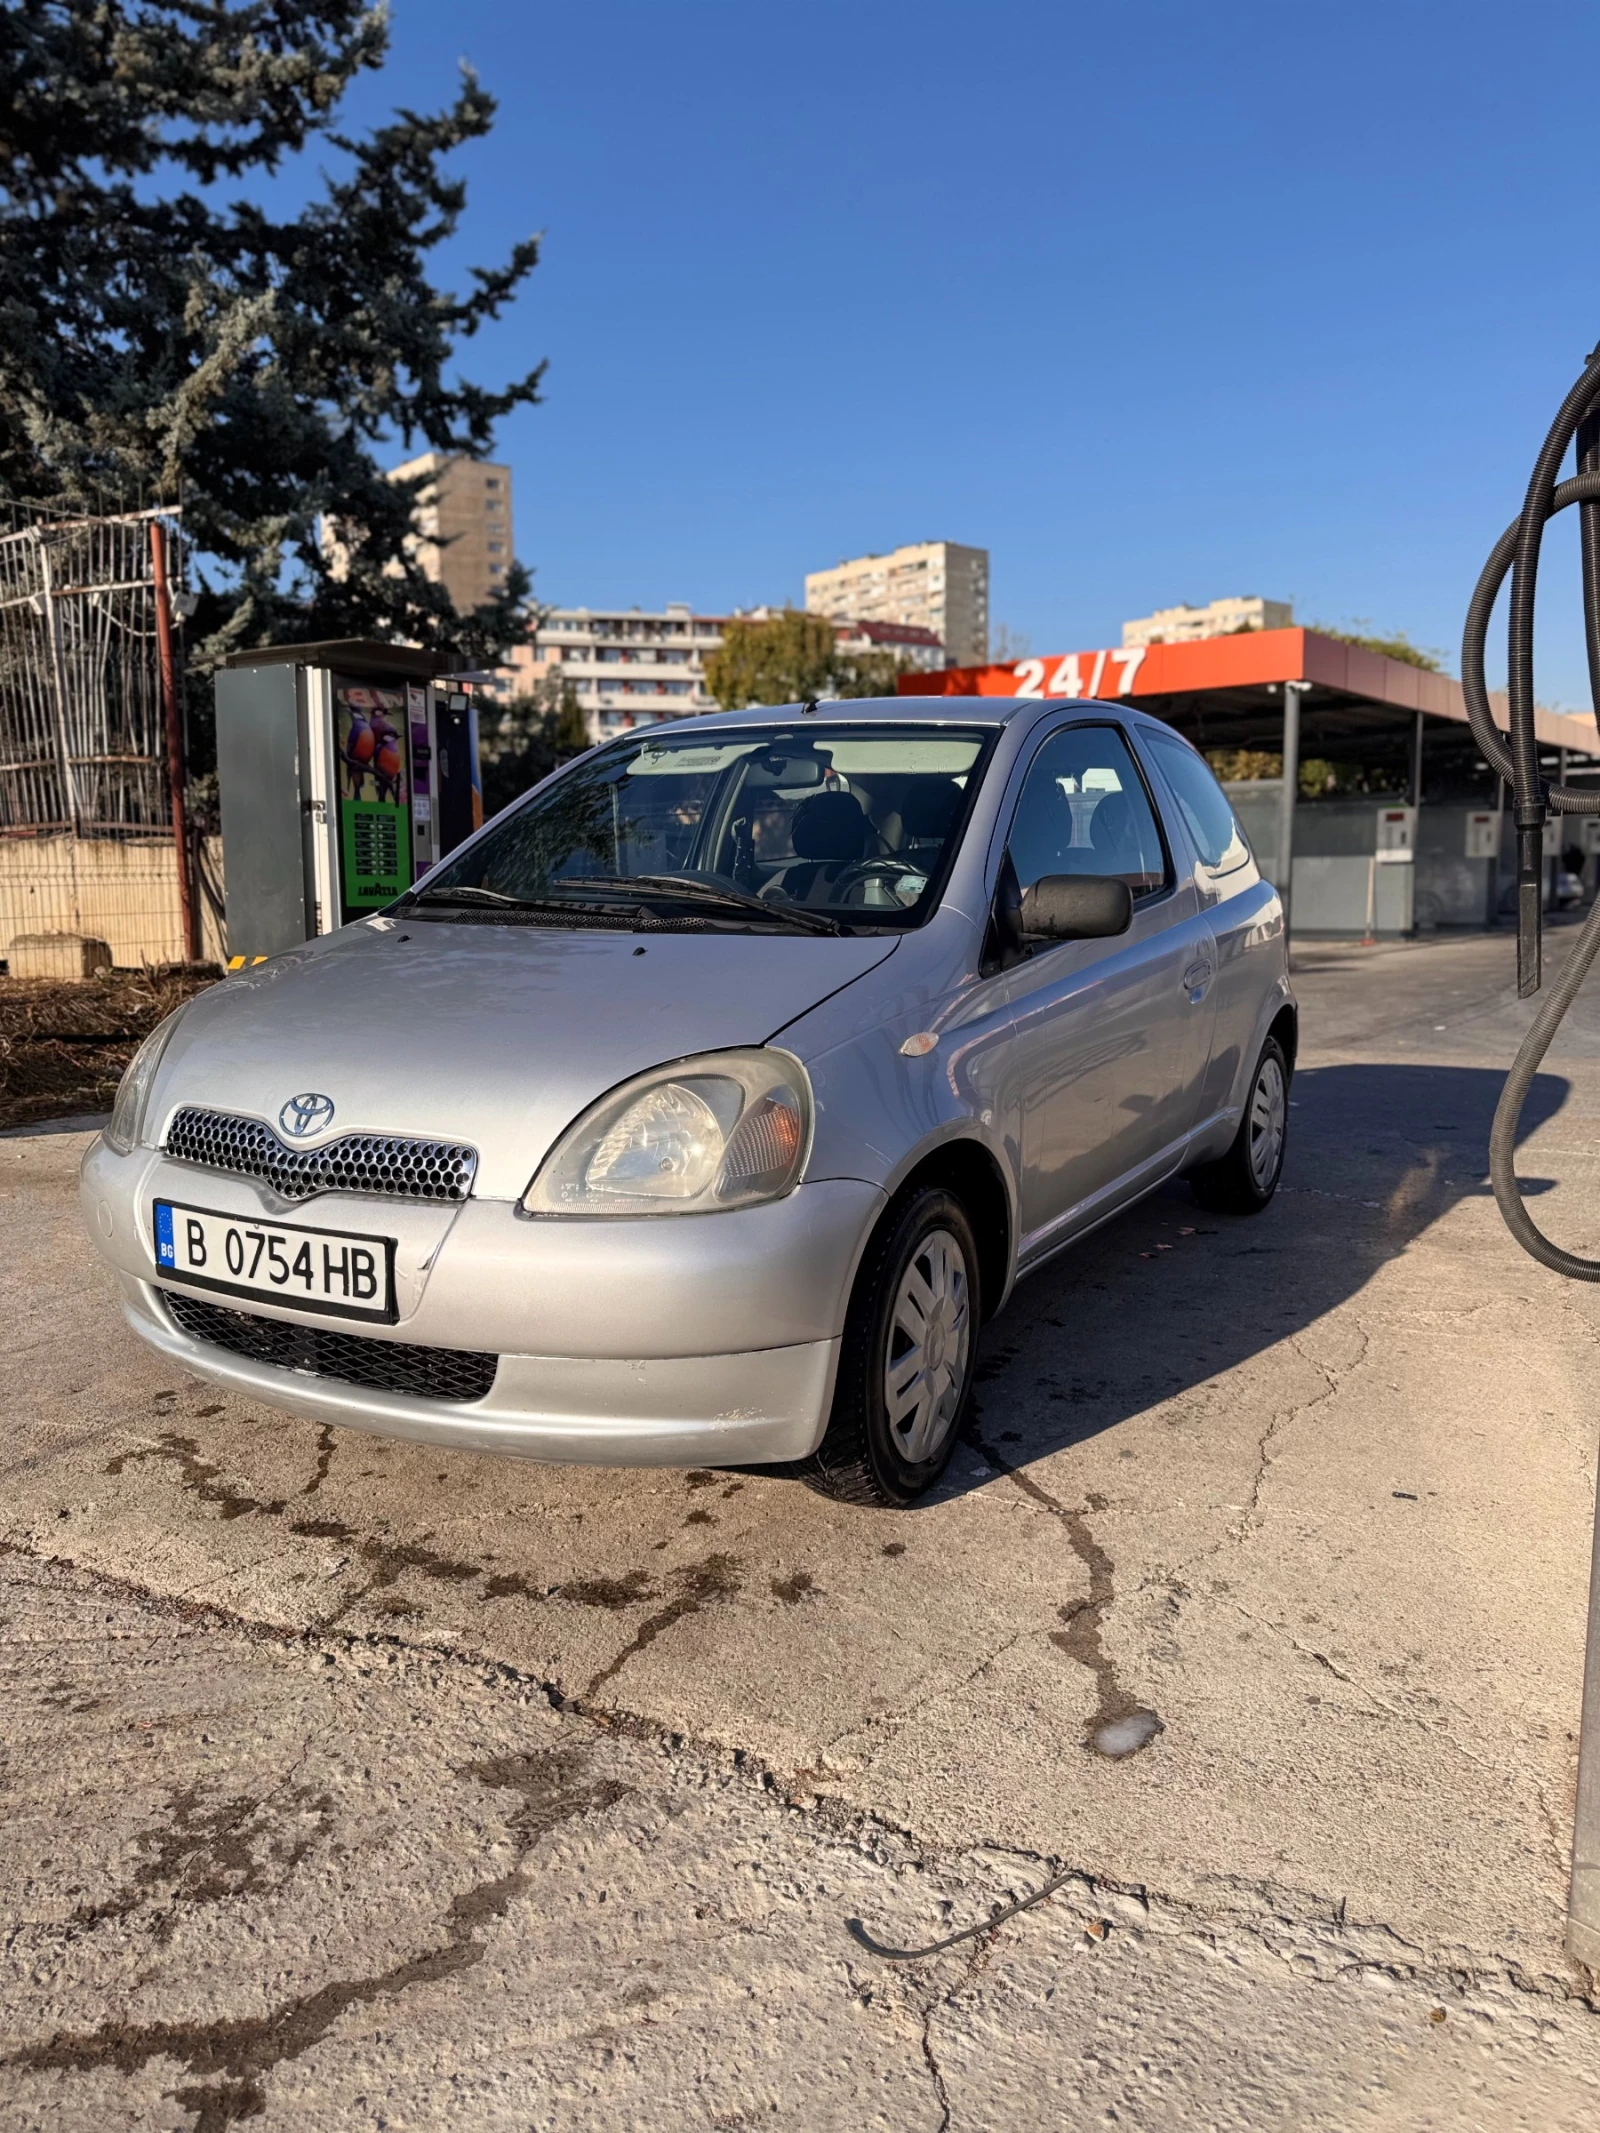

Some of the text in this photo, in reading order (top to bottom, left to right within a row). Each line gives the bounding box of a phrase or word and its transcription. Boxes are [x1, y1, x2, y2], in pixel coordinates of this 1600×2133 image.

[1013, 648, 1146, 698] 24/7
[358, 882, 398, 896] LAVAZZA
[161, 1243, 173, 1258] BG
[187, 1218, 207, 1267] B
